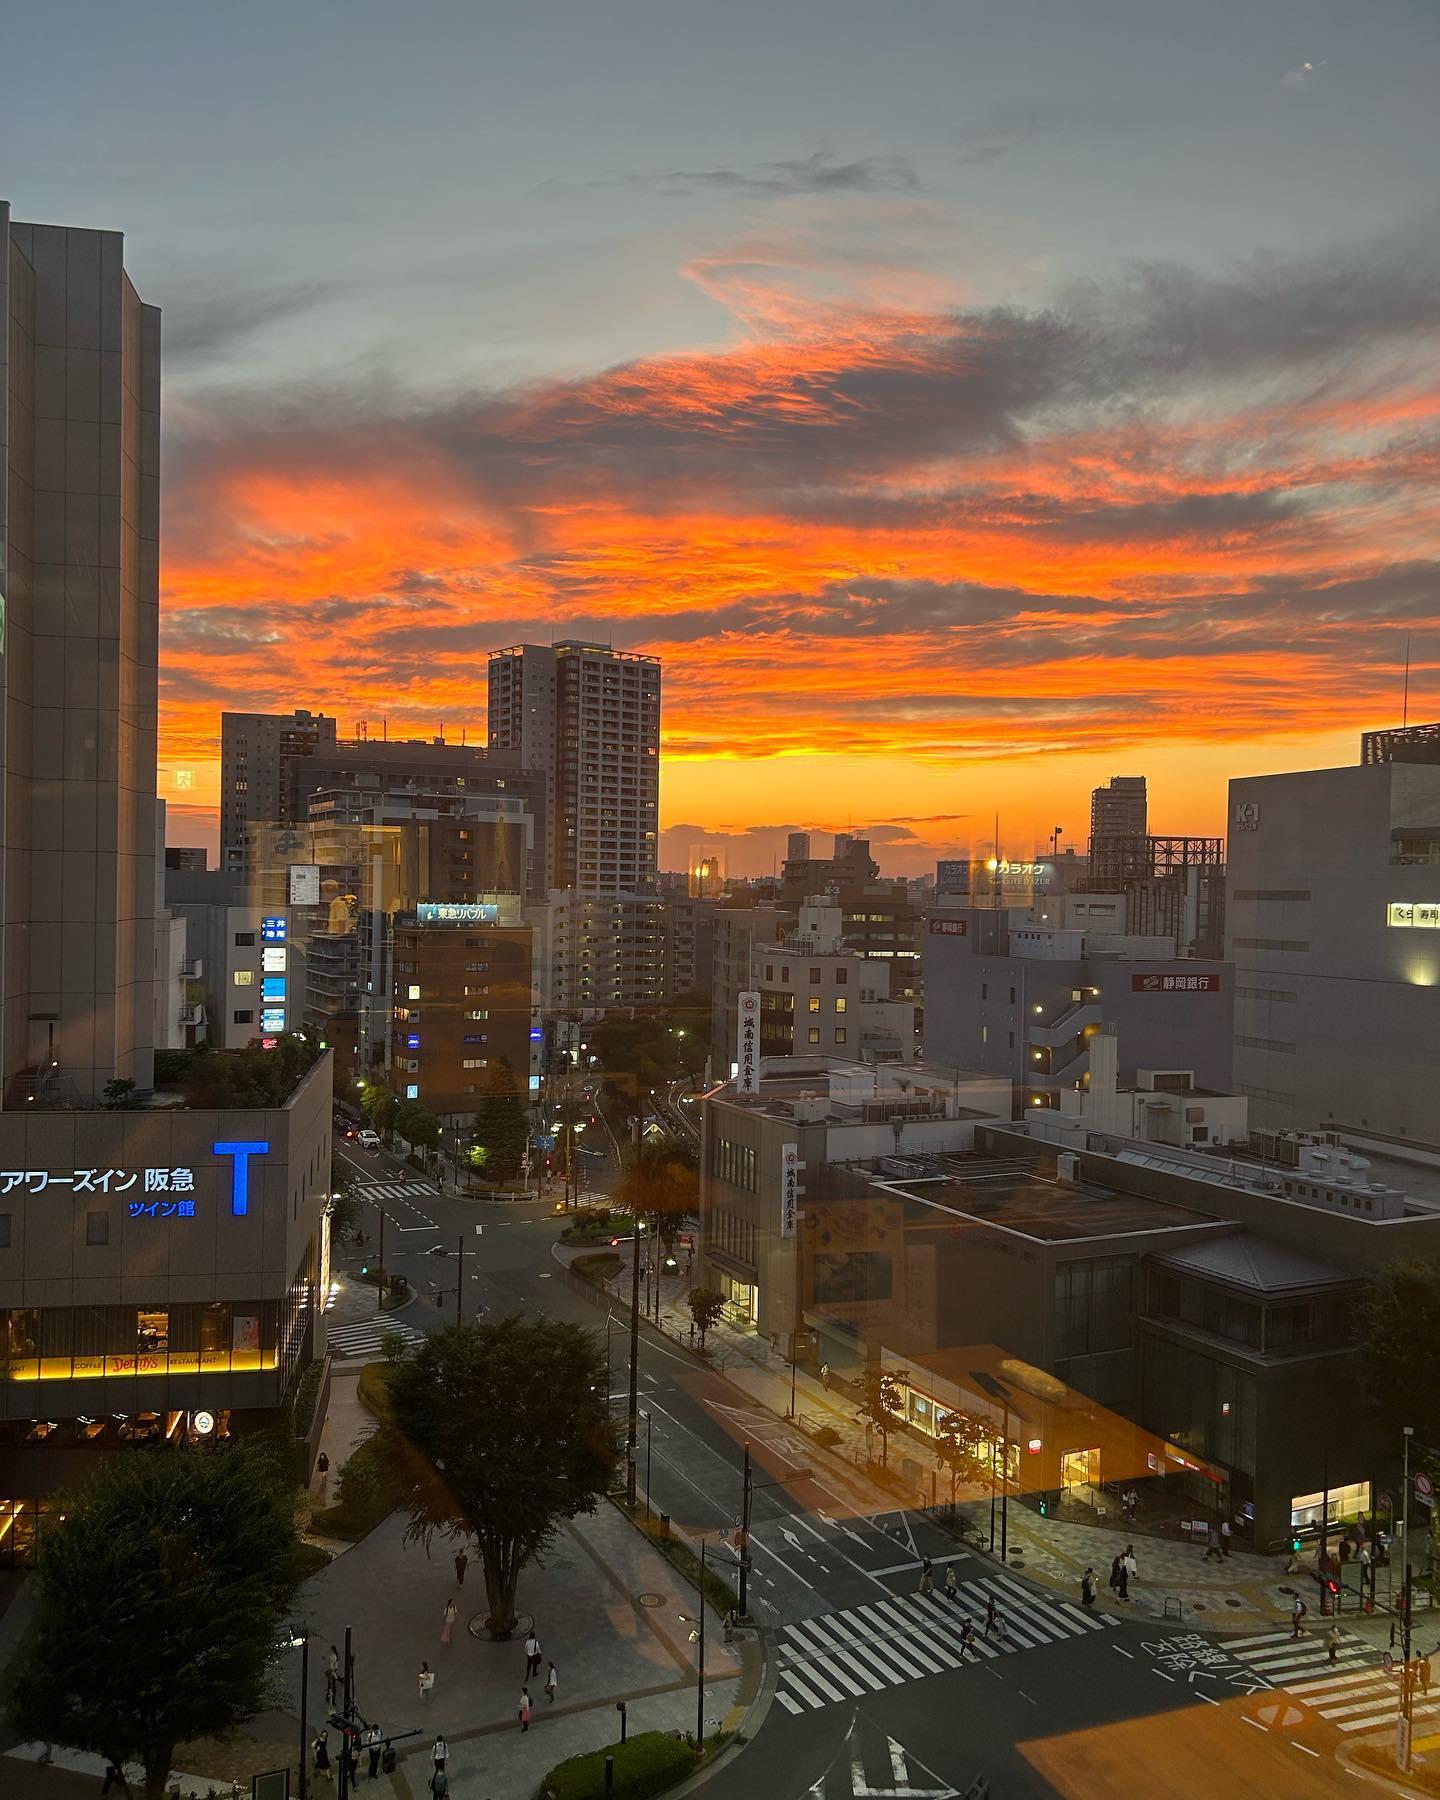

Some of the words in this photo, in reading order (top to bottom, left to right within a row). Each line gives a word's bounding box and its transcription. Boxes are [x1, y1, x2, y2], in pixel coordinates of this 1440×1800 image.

[998, 863, 1045, 875] カラオケ
[1162, 976, 1209, 990] 静岡銀行
[743, 1016, 755, 1092] 城南信用金庫
[0, 1168, 138, 1194] アワーズイン
[144, 1167, 195, 1192] 阪急
[213, 1141, 269, 1216] T
[129, 1200, 195, 1217] ツイン館
[785, 1168, 796, 1232] 城南信用金庫
[112, 1355, 158, 1373] Denny's
